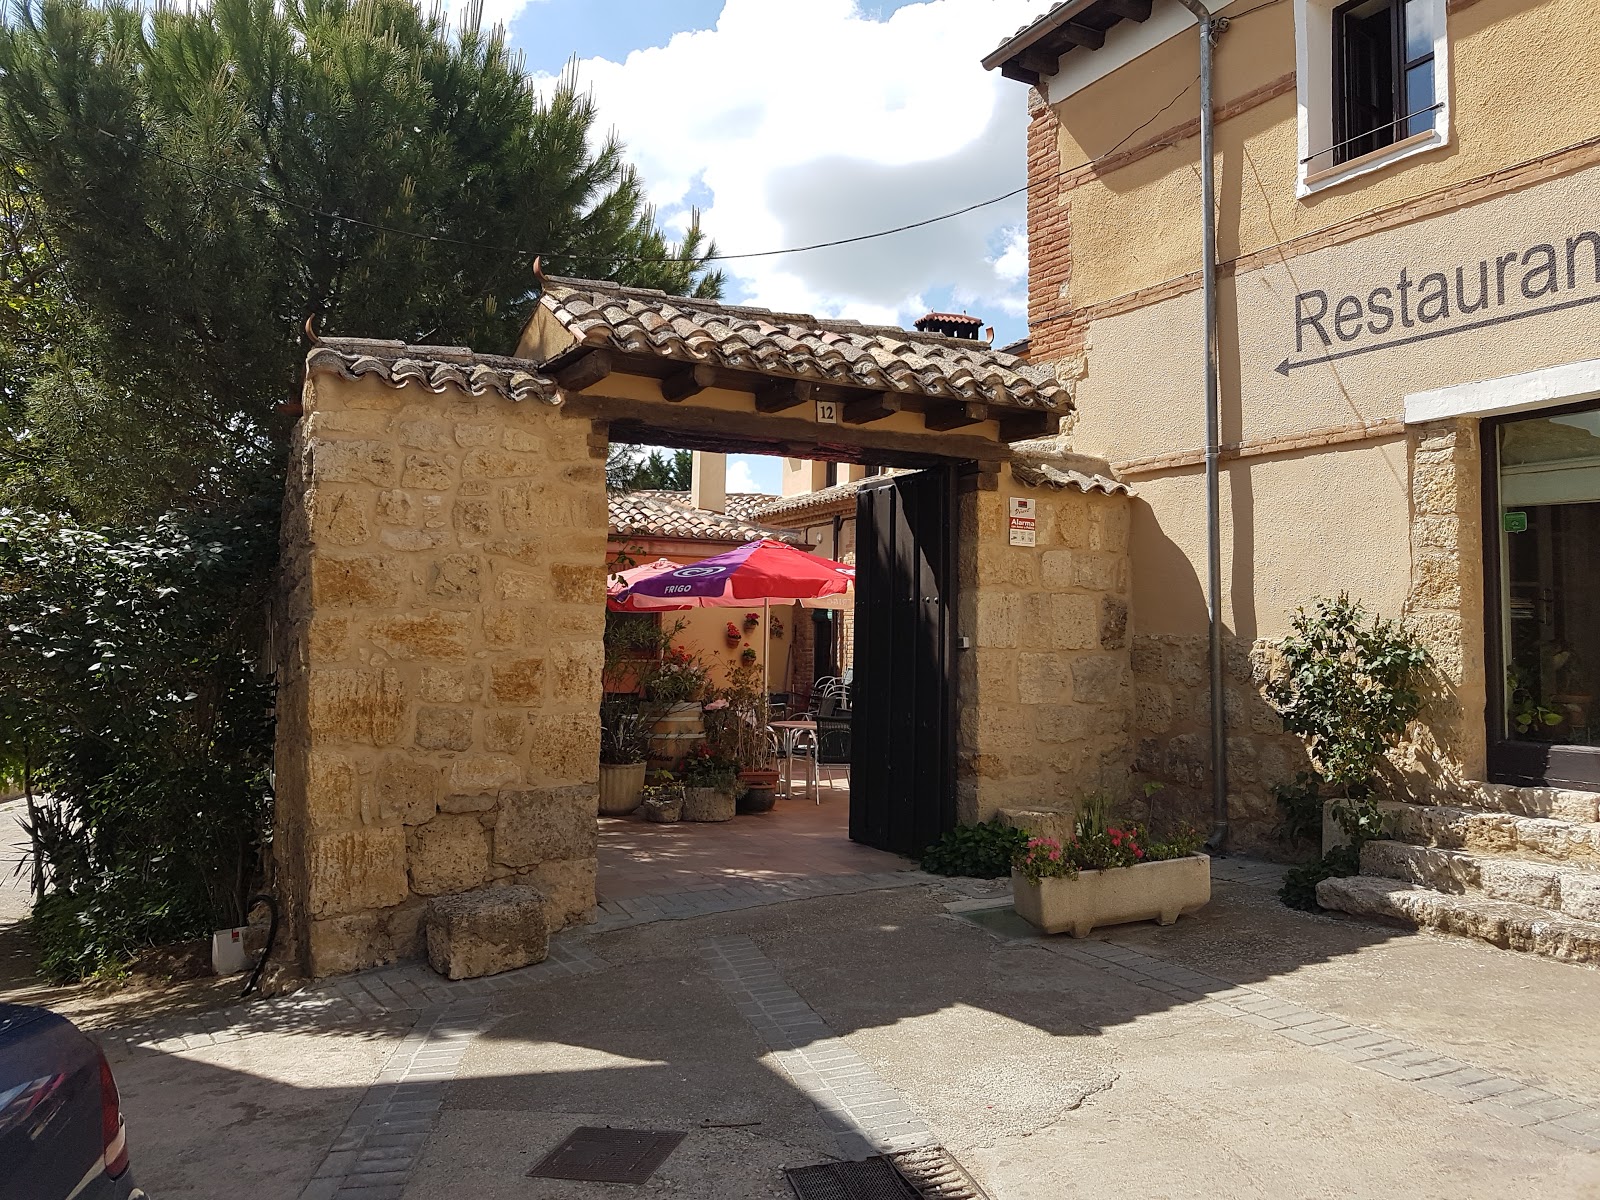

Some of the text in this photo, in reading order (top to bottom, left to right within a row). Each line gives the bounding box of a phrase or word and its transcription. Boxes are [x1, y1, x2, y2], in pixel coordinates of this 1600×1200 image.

[1294, 230, 1600, 353] Restauran
[820, 405, 834, 420] 12
[1011, 518, 1035, 527] Alarma
[664, 584, 692, 594] FRIGO
